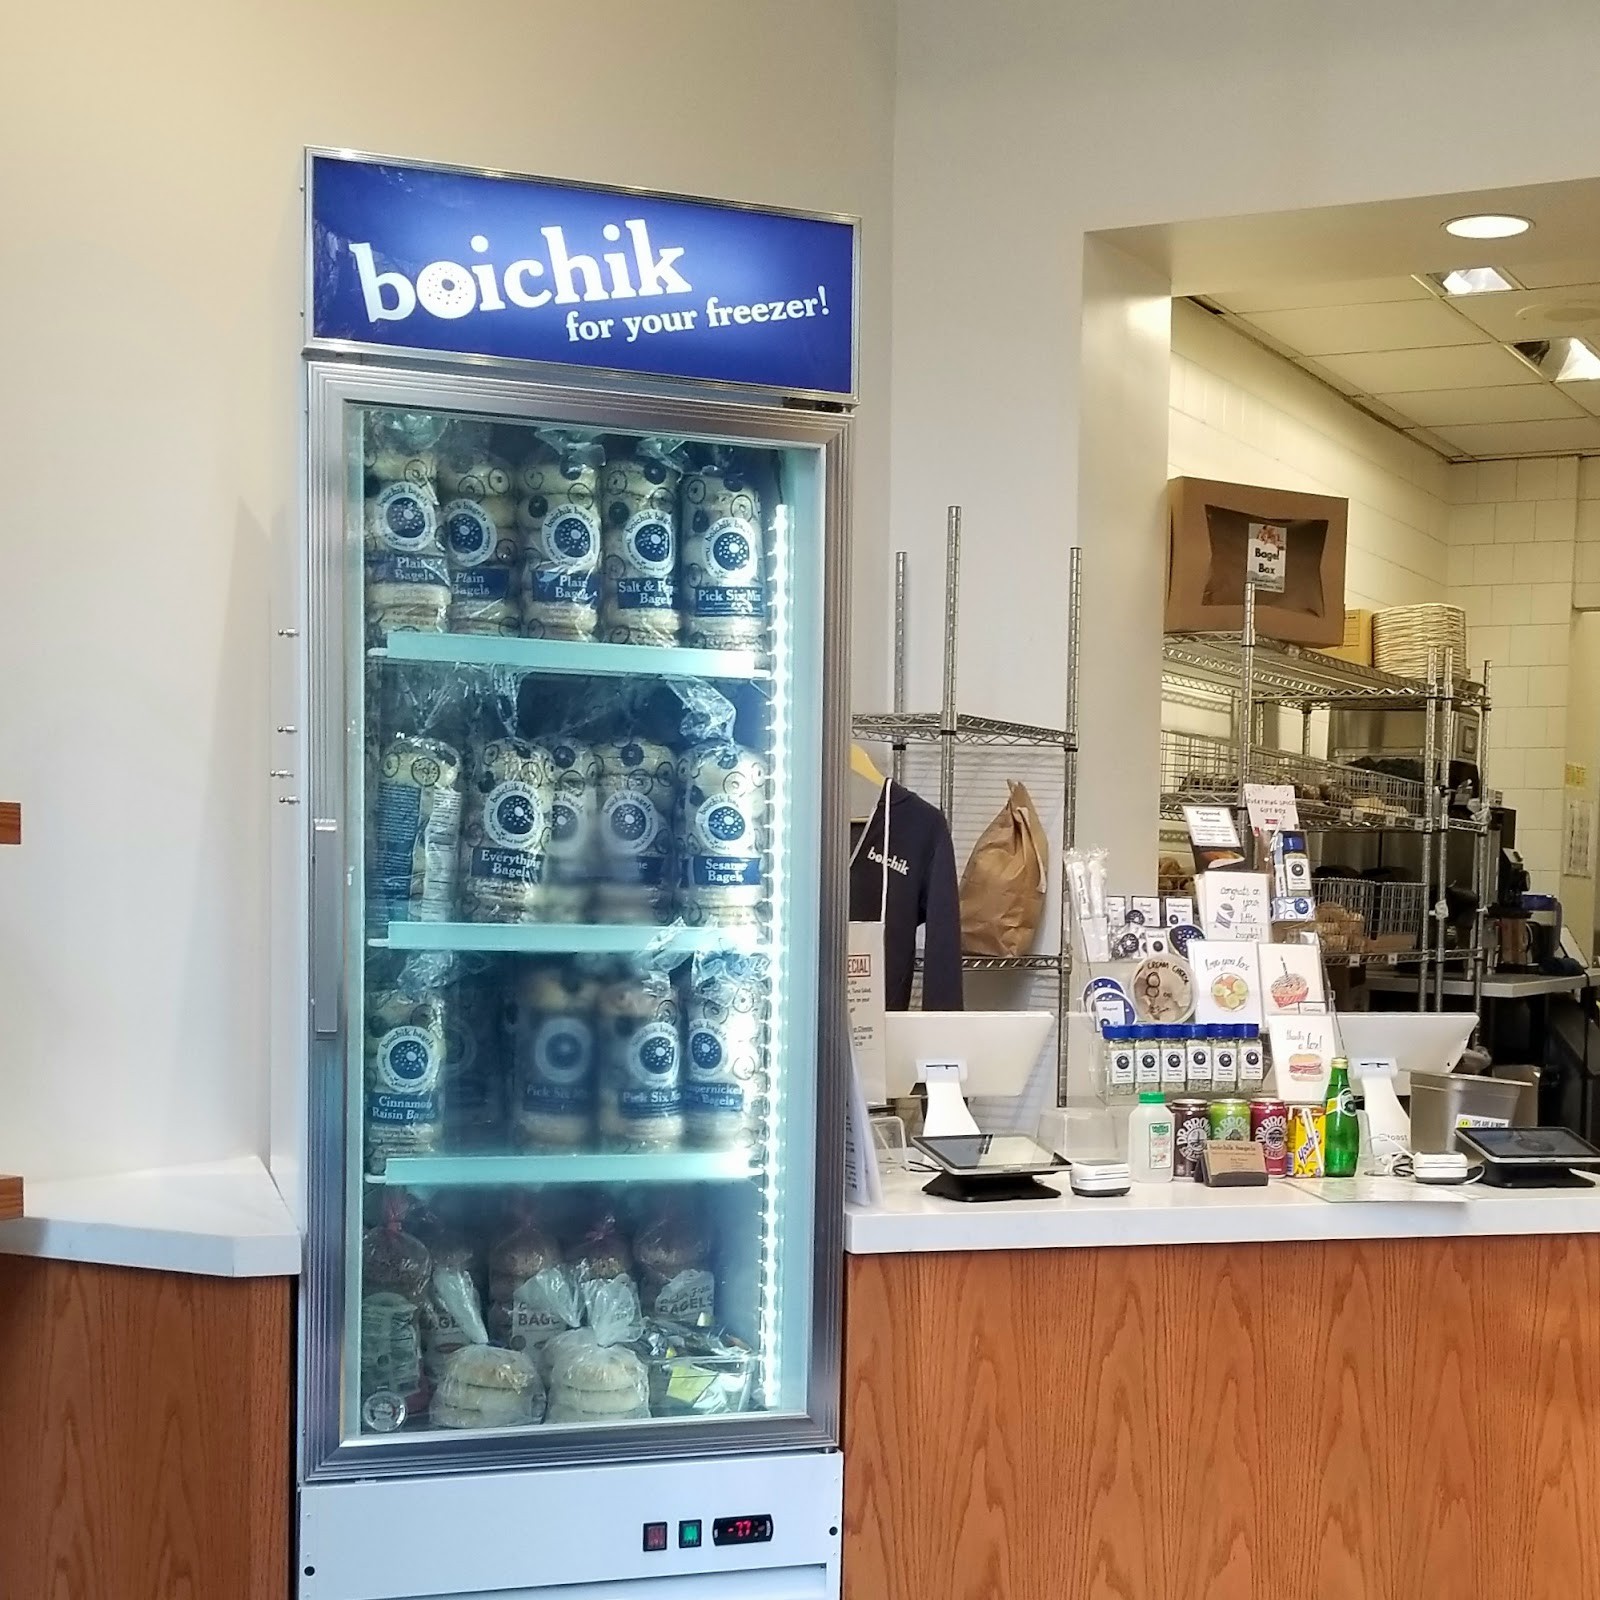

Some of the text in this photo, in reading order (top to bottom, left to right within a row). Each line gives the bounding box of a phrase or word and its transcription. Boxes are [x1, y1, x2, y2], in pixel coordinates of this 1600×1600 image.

[349, 219, 692, 323] boichik
[565, 285, 830, 343] for your freezer!
[544, 506, 572, 529] boichik
[626, 510, 652, 534] boichik
[706, 519, 731, 542] boichik
[1255, 547, 1280, 562] Bagel
[395, 569, 435, 582] Bagels
[1258, 563, 1276, 575] Box
[454, 572, 485, 583] Plain
[451, 585, 490, 597] Bagels
[618, 581, 641, 594] Salt
[643, 581, 655, 593] &
[698, 589, 723, 602] Pick
[481, 849, 542, 871] Everything
[705, 858, 749, 871] Sesame
[492, 862, 531, 879] Bagels
[708, 869, 745, 883] Bagels
[379, 1095, 433, 1109] Cinnamon
[651, 1090, 670, 1103] Six
[372, 1106, 403, 1119] Raisin
